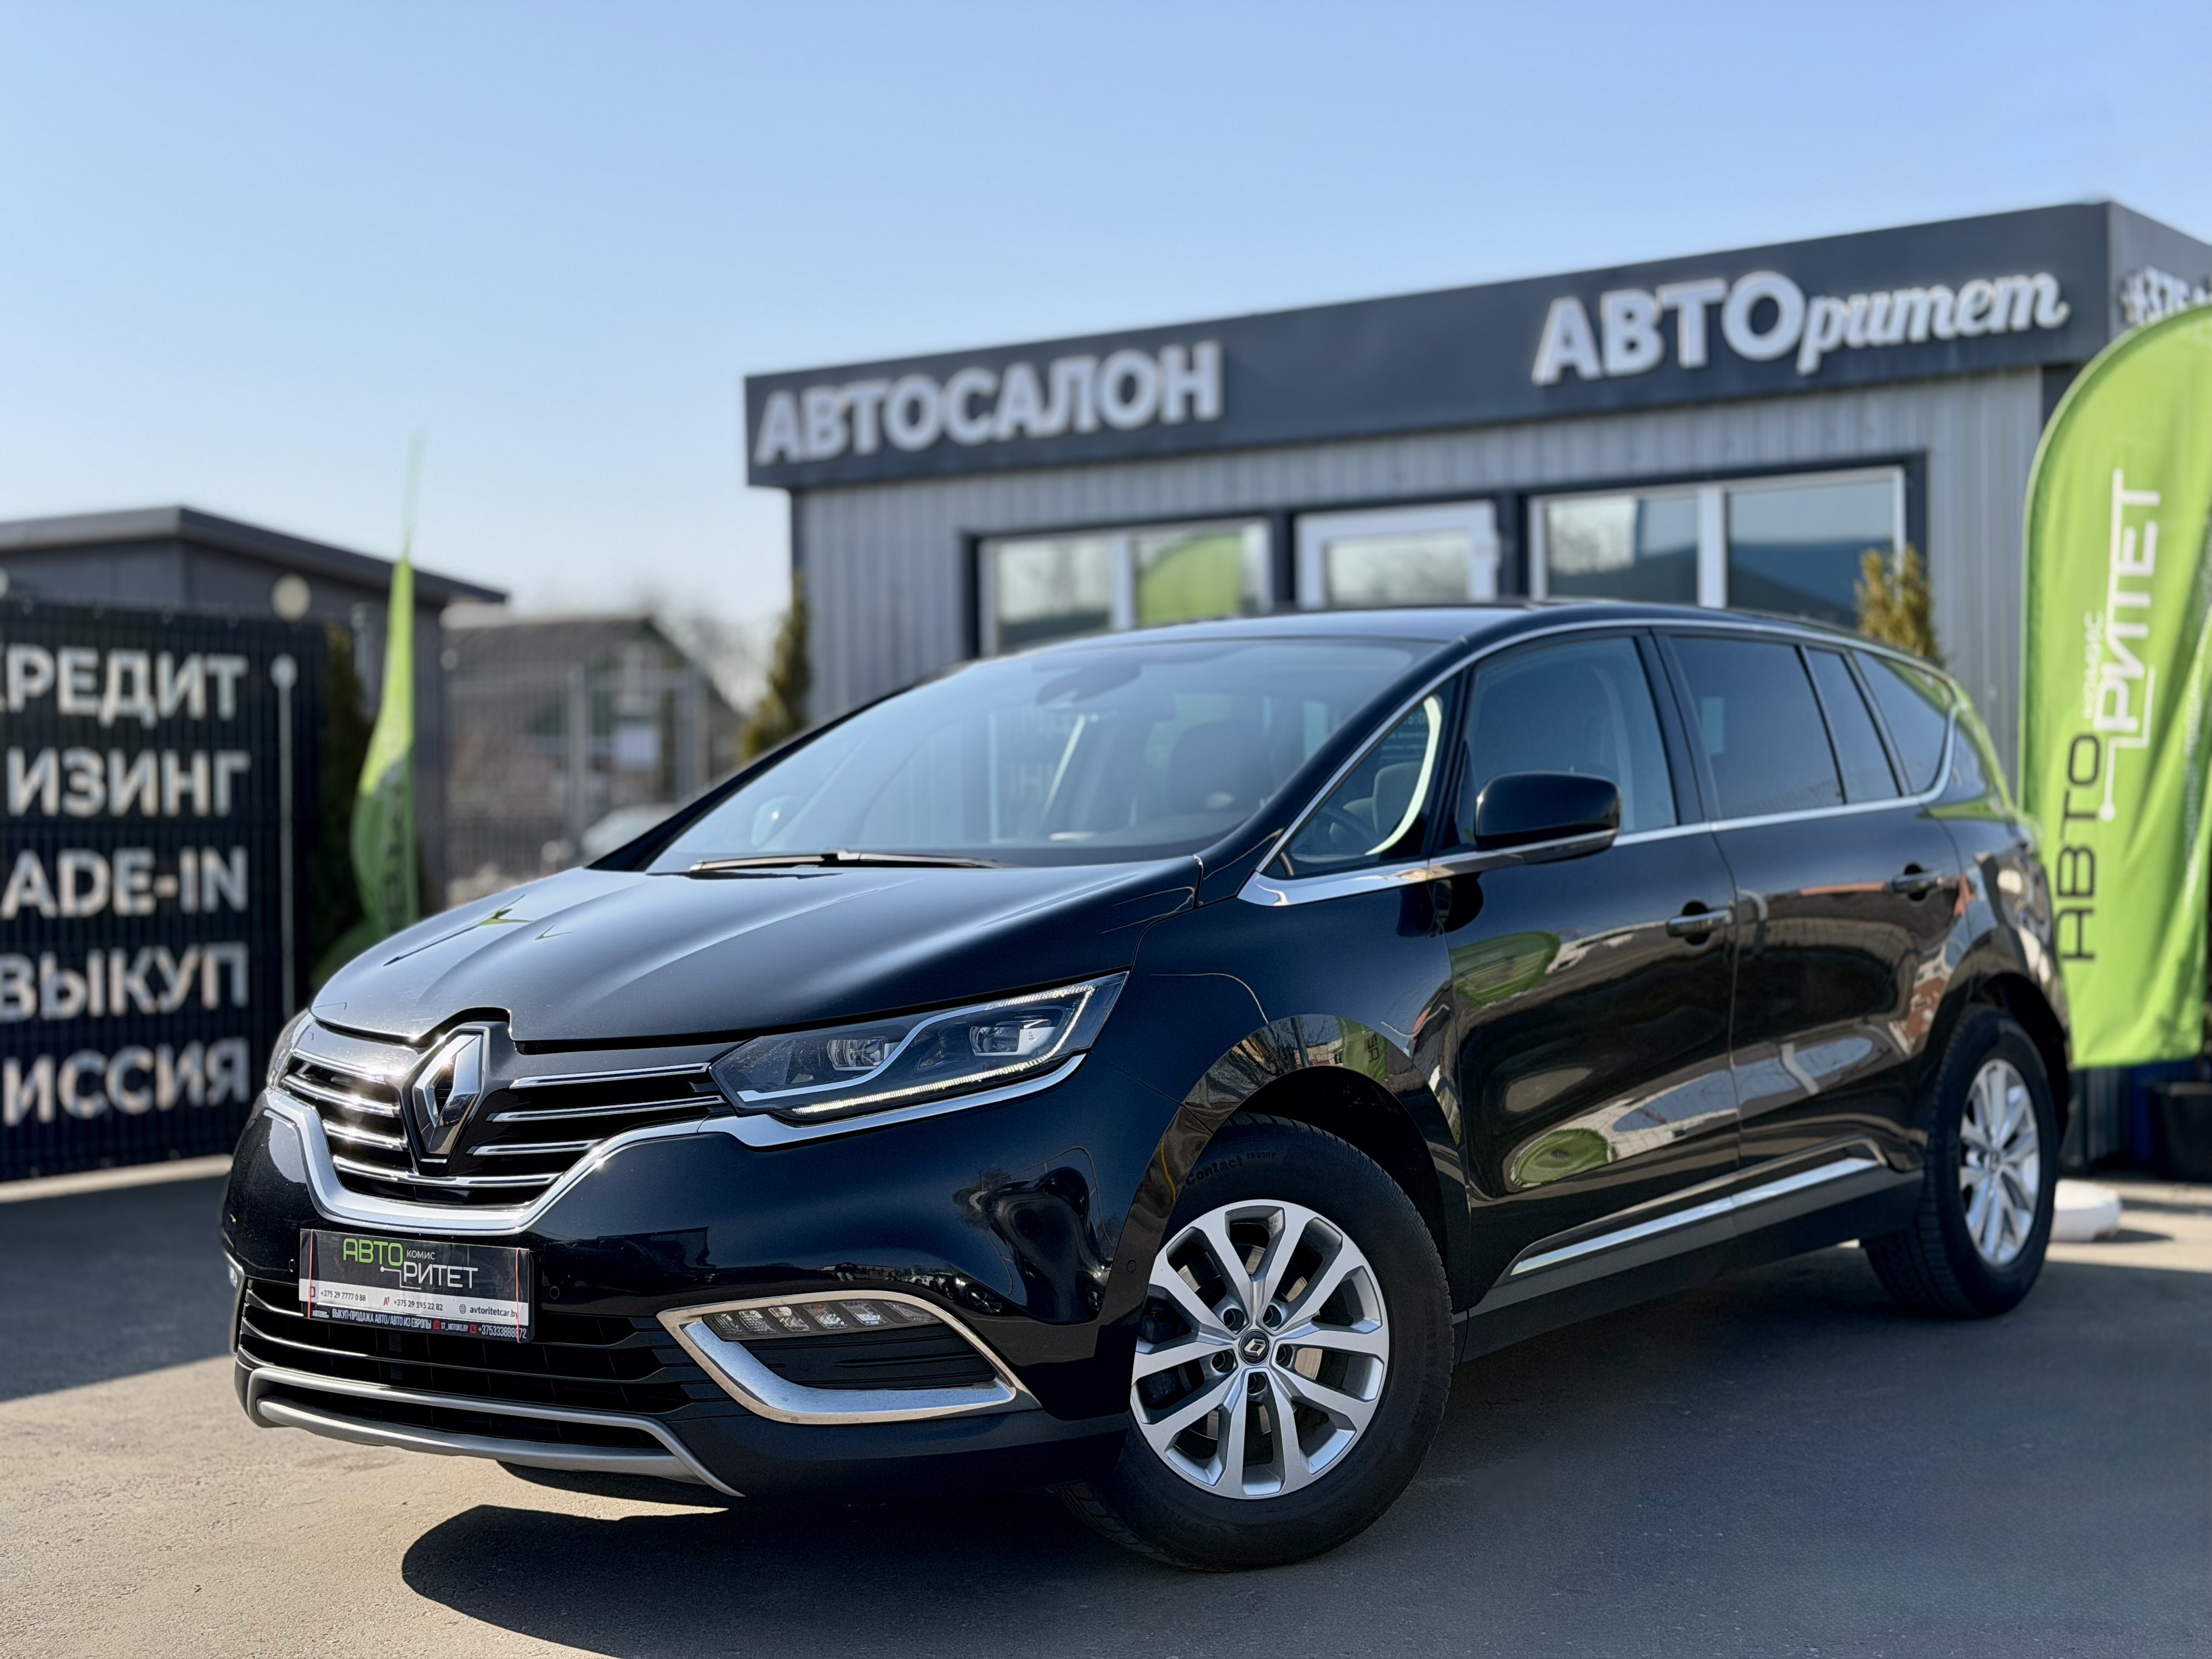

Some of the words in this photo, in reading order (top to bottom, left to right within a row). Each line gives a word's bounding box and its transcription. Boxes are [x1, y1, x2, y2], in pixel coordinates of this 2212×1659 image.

[754, 340, 1222, 466] АВТОСАЛОН
[2095, 468, 2161, 733] РИТЕТ
[0, 643, 249, 729] РЕДИТ
[7, 747, 251, 817] ИЗИНГ
[1, 845, 249, 919] ADE-IN
[2055, 733, 2101, 961] АВТО
[0, 940, 249, 1023] ВЫКУП
[3, 1037, 250, 1127] ИССИЯ
[343, 1238, 403, 1266] АВТО
[404, 1261, 478, 1289] РИТЕТ
[407, 1250, 436, 1260] КОМИС
[320, 1290, 333, 1298] +375
[341, 1292, 354, 1300] 7777
[332, 1308, 374, 1323] ВЫКУП-ПРОДАЖА
[375, 1313, 403, 1327] АВТО/АВТО
[403, 1317, 411, 1327] ИЗ
[411, 1317, 432, 1329] ЕВРОПЫ
[394, 1299, 407, 1307] +375
[416, 1301, 427, 1309] 195
[470, 1306, 518, 1319] avtoritetcar.by
